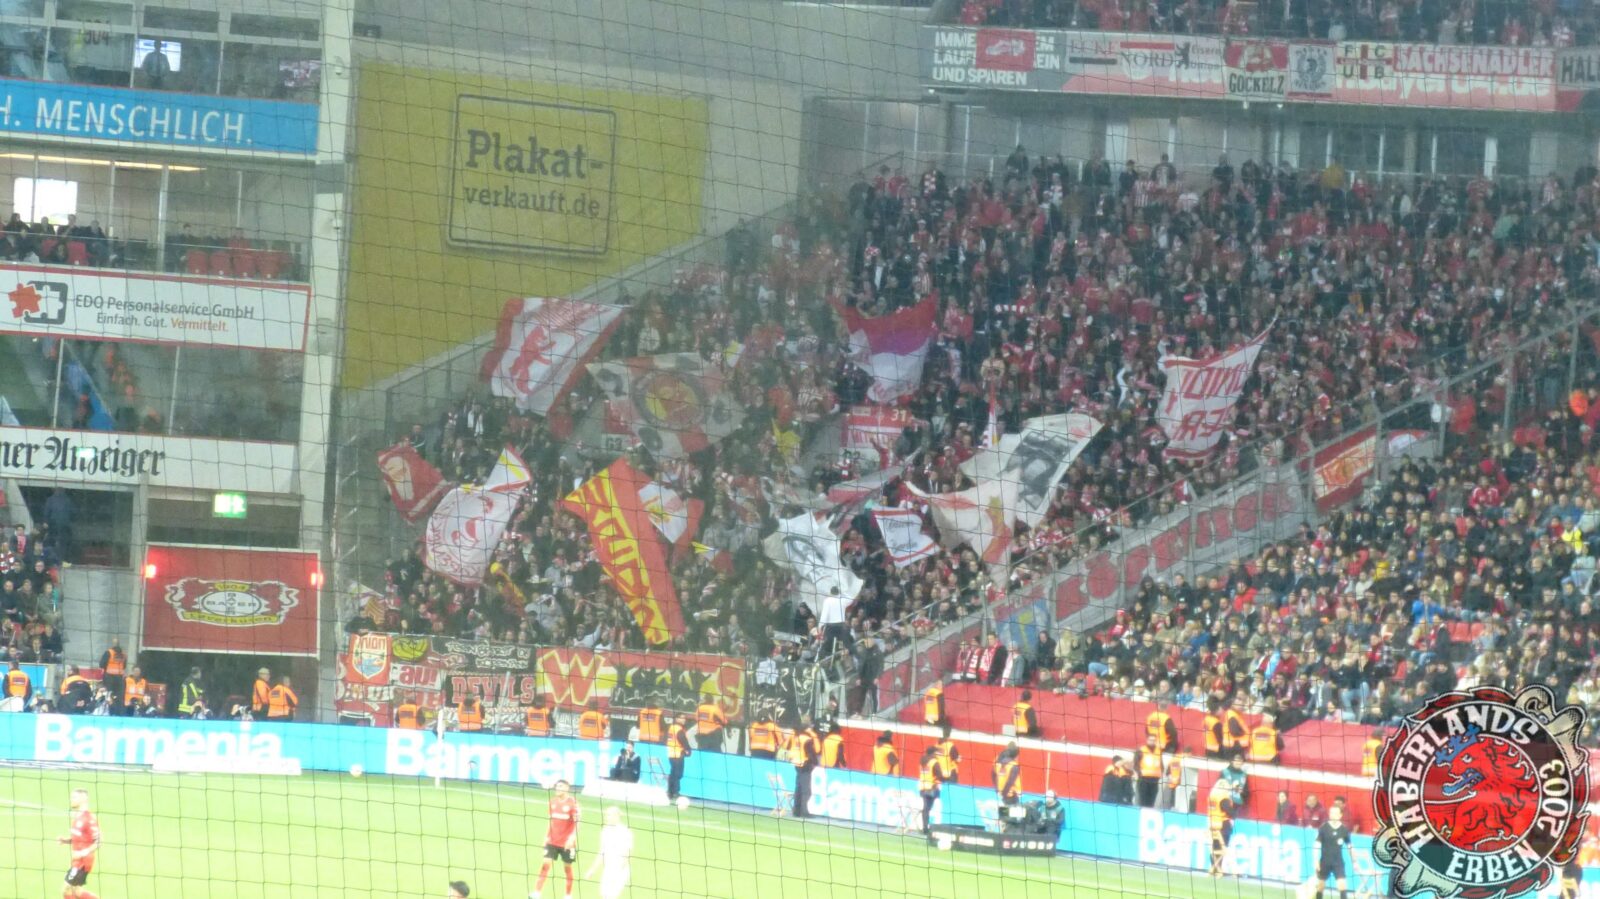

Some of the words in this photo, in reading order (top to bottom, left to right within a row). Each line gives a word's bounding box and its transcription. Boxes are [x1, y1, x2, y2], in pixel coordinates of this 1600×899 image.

[934, 31, 977, 48] IMME
[1397, 44, 1553, 76] SACHSENADLER
[1561, 55, 1600, 84] HAL
[932, 67, 966, 82] UND
[967, 69, 1028, 86] SPAREN
[36, 97, 253, 145] MENSCHLICH.
[465, 129, 604, 179] Plakat-
[463, 186, 600, 219] verkauft.de
[75, 294, 104, 309] EDO
[107, 296, 211, 317] Personalservice
[212, 303, 255, 320] GmbH
[96, 312, 141, 327] Einfach.
[143, 315, 168, 329] Gut.
[170, 317, 229, 333] Vermittelt.
[43, 436, 166, 478] Anzeiger
[451, 675, 535, 705] DEVILS
[34, 713, 284, 763] Barmenia
[385, 728, 622, 788] Barmeni
